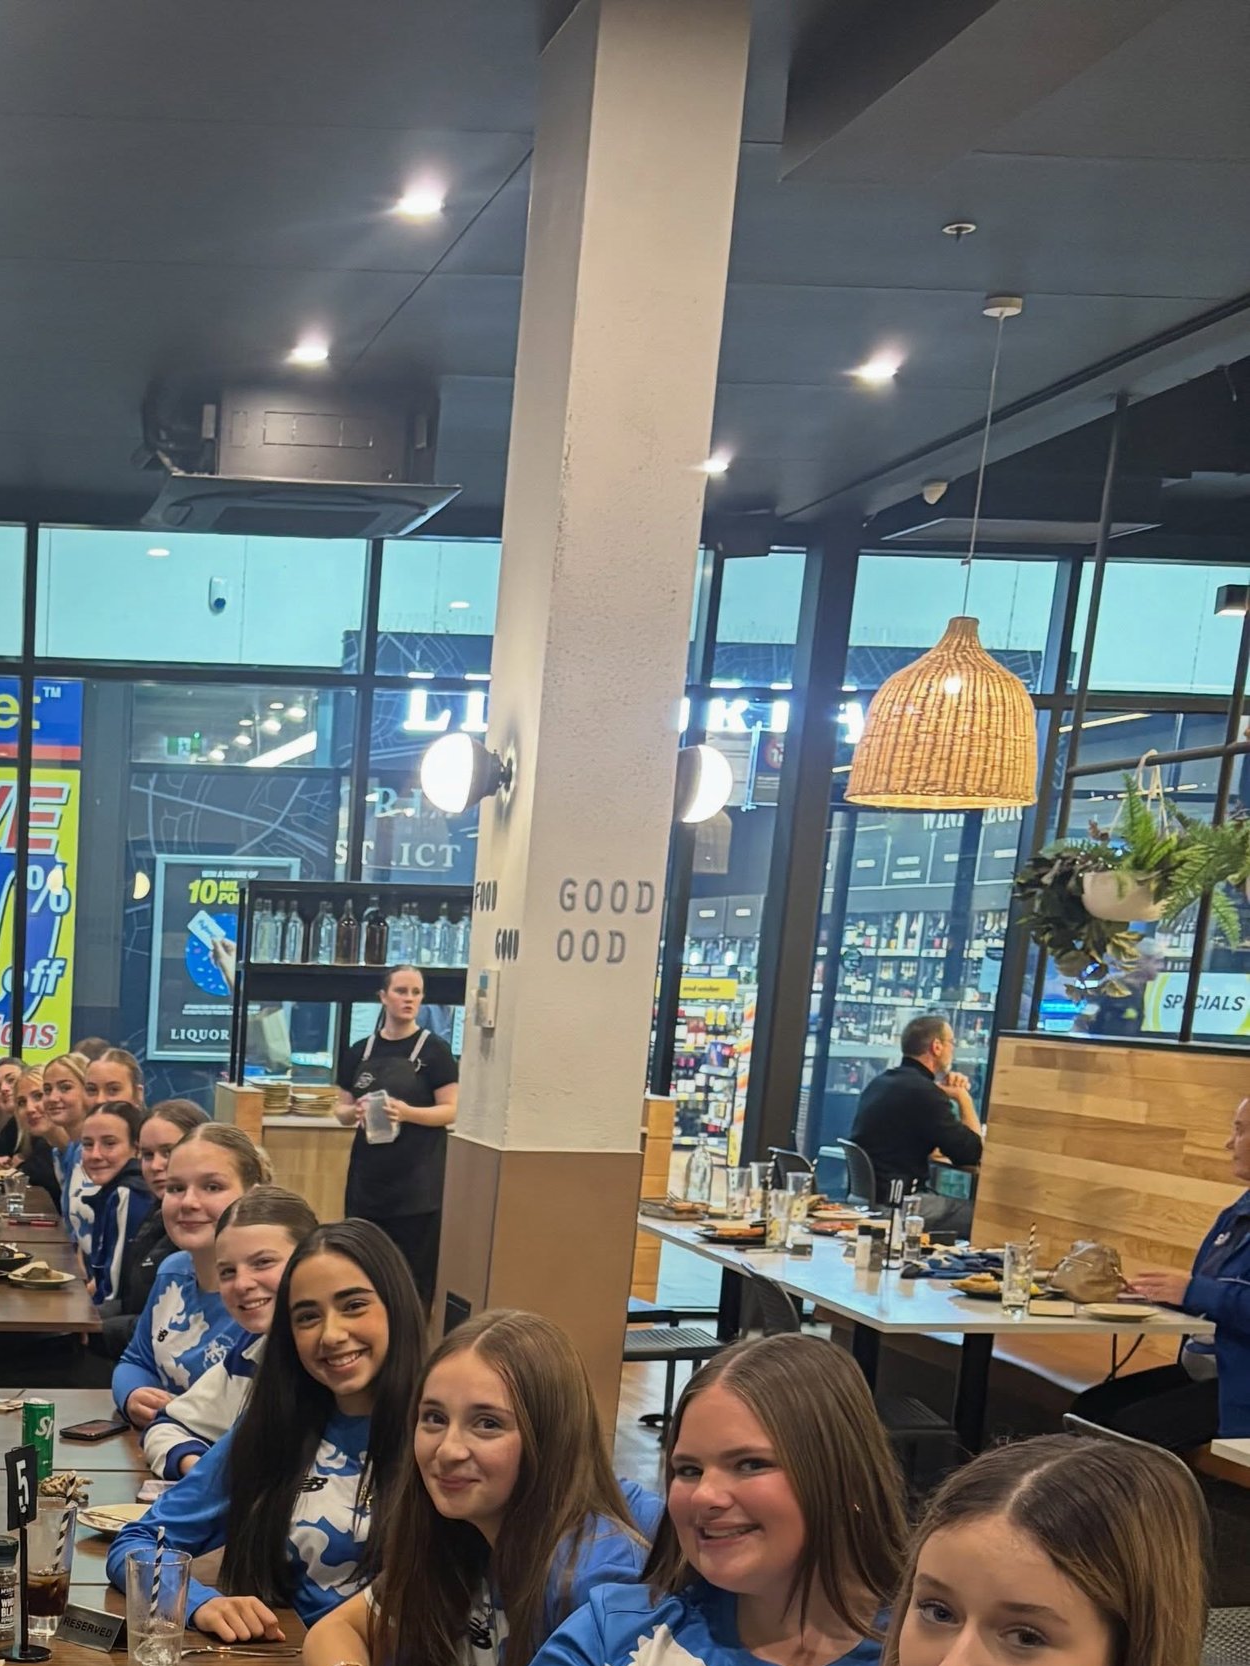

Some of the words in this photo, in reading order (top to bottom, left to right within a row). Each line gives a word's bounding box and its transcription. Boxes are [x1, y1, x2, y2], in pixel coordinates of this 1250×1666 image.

[188, 879, 218, 905] 10
[559, 877, 655, 914] GOOD
[556, 929, 626, 963] OOD
[1162, 993, 1246, 1012] SPCIALS
[170, 1028, 230, 1043] LIQUOR
[889, 1179, 904, 1205] 10
[15, 1459, 31, 1514] 5
[63, 1616, 114, 1639] RESERVED
